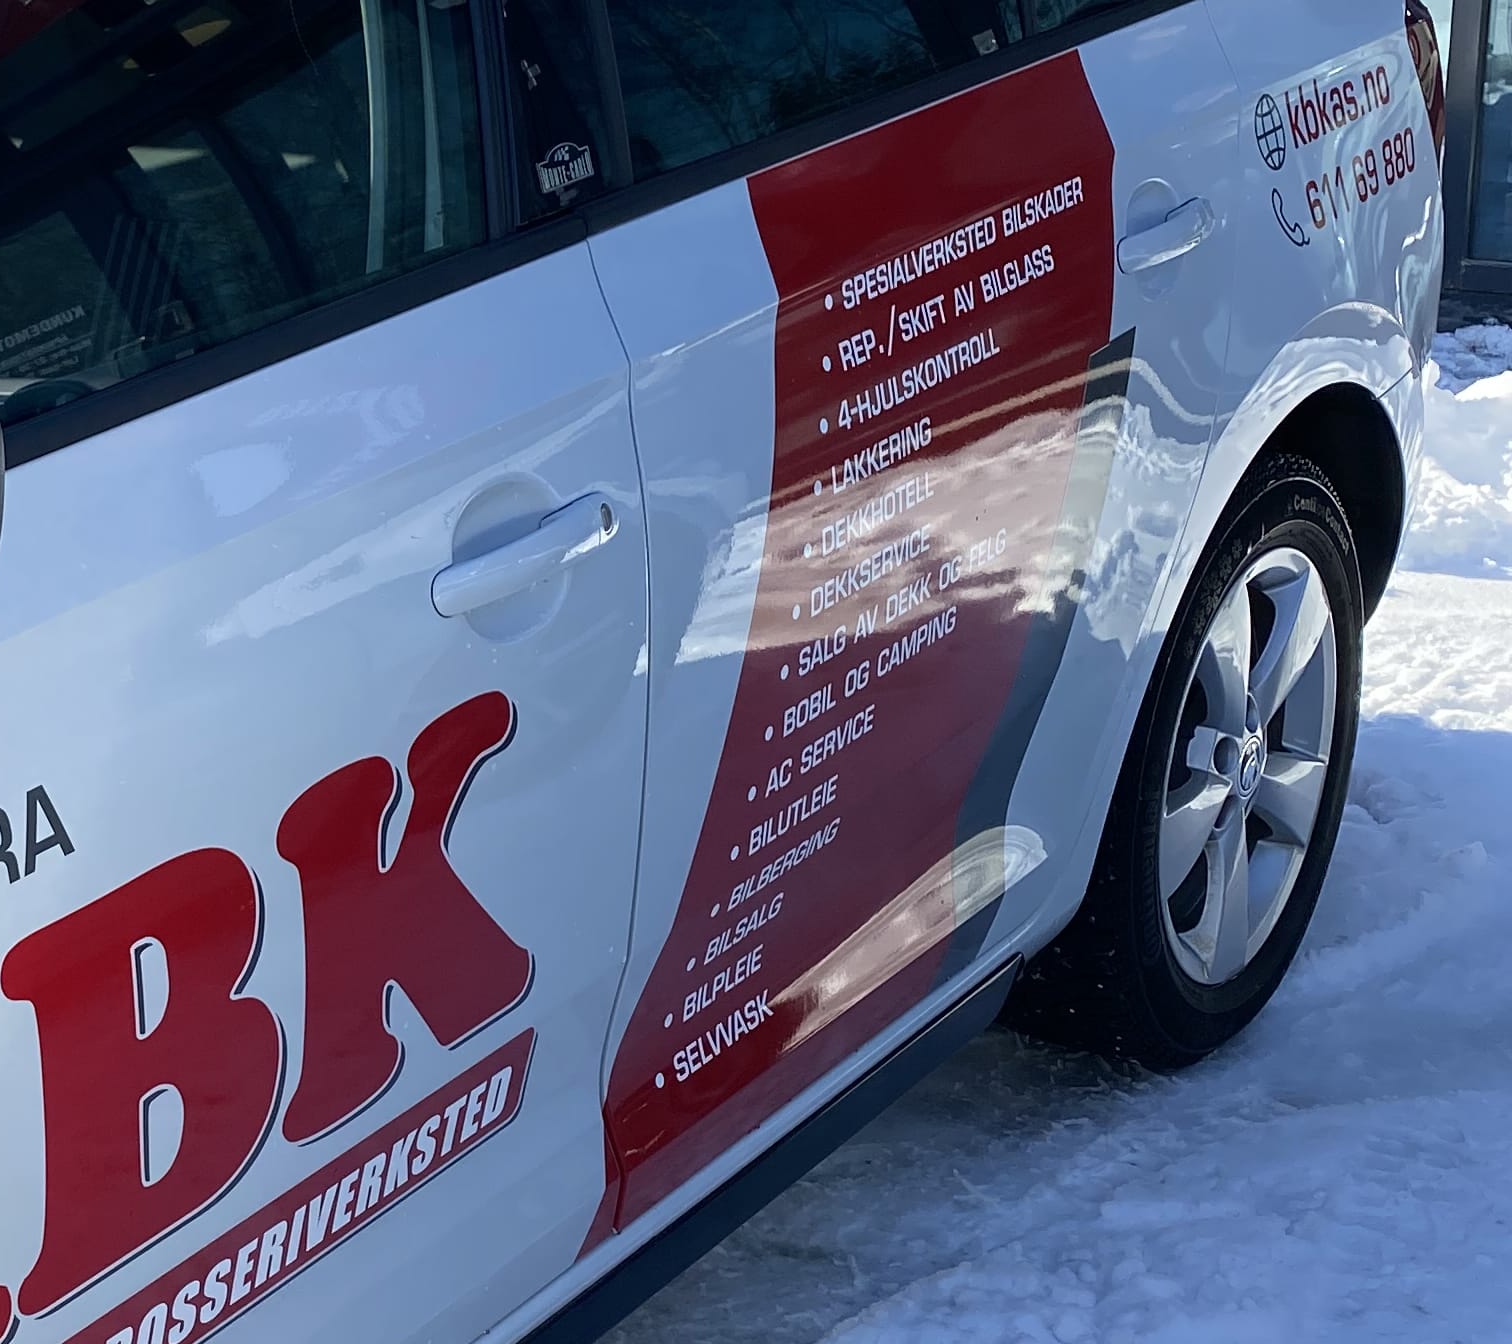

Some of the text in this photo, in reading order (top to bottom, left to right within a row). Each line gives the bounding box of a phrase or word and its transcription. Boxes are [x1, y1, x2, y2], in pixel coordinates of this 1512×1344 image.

[1285, 66, 1390, 149] kbkas.no
[1305, 127, 1415, 229] 611 69 880
[842, 176, 1084, 310] SPESIALVERKSTED BILSKADER
[954, 281, 974, 317] AV
[980, 244, 1054, 303] BILGLASS
[837, 327, 1001, 430] 4-HJULSKONTROLL
[831, 417, 932, 495] LAKKERING
[822, 471, 934, 556] DEKKHOTELL
[799, 528, 1006, 677] SALG AV DEKK OG FELG
[810, 523, 930, 617] DEKKSERVICE
[782, 606, 957, 738] BOBIL OG CAMPING
[765, 705, 875, 798] AC SERVICE
[748, 774, 839, 856] BILUTLEIE
[727, 817, 840, 912] BILBERGING
[704, 892, 784, 965] BILSALG
[682, 944, 763, 1022] BILPLEIE
[673, 989, 775, 1082] SELVVASK
